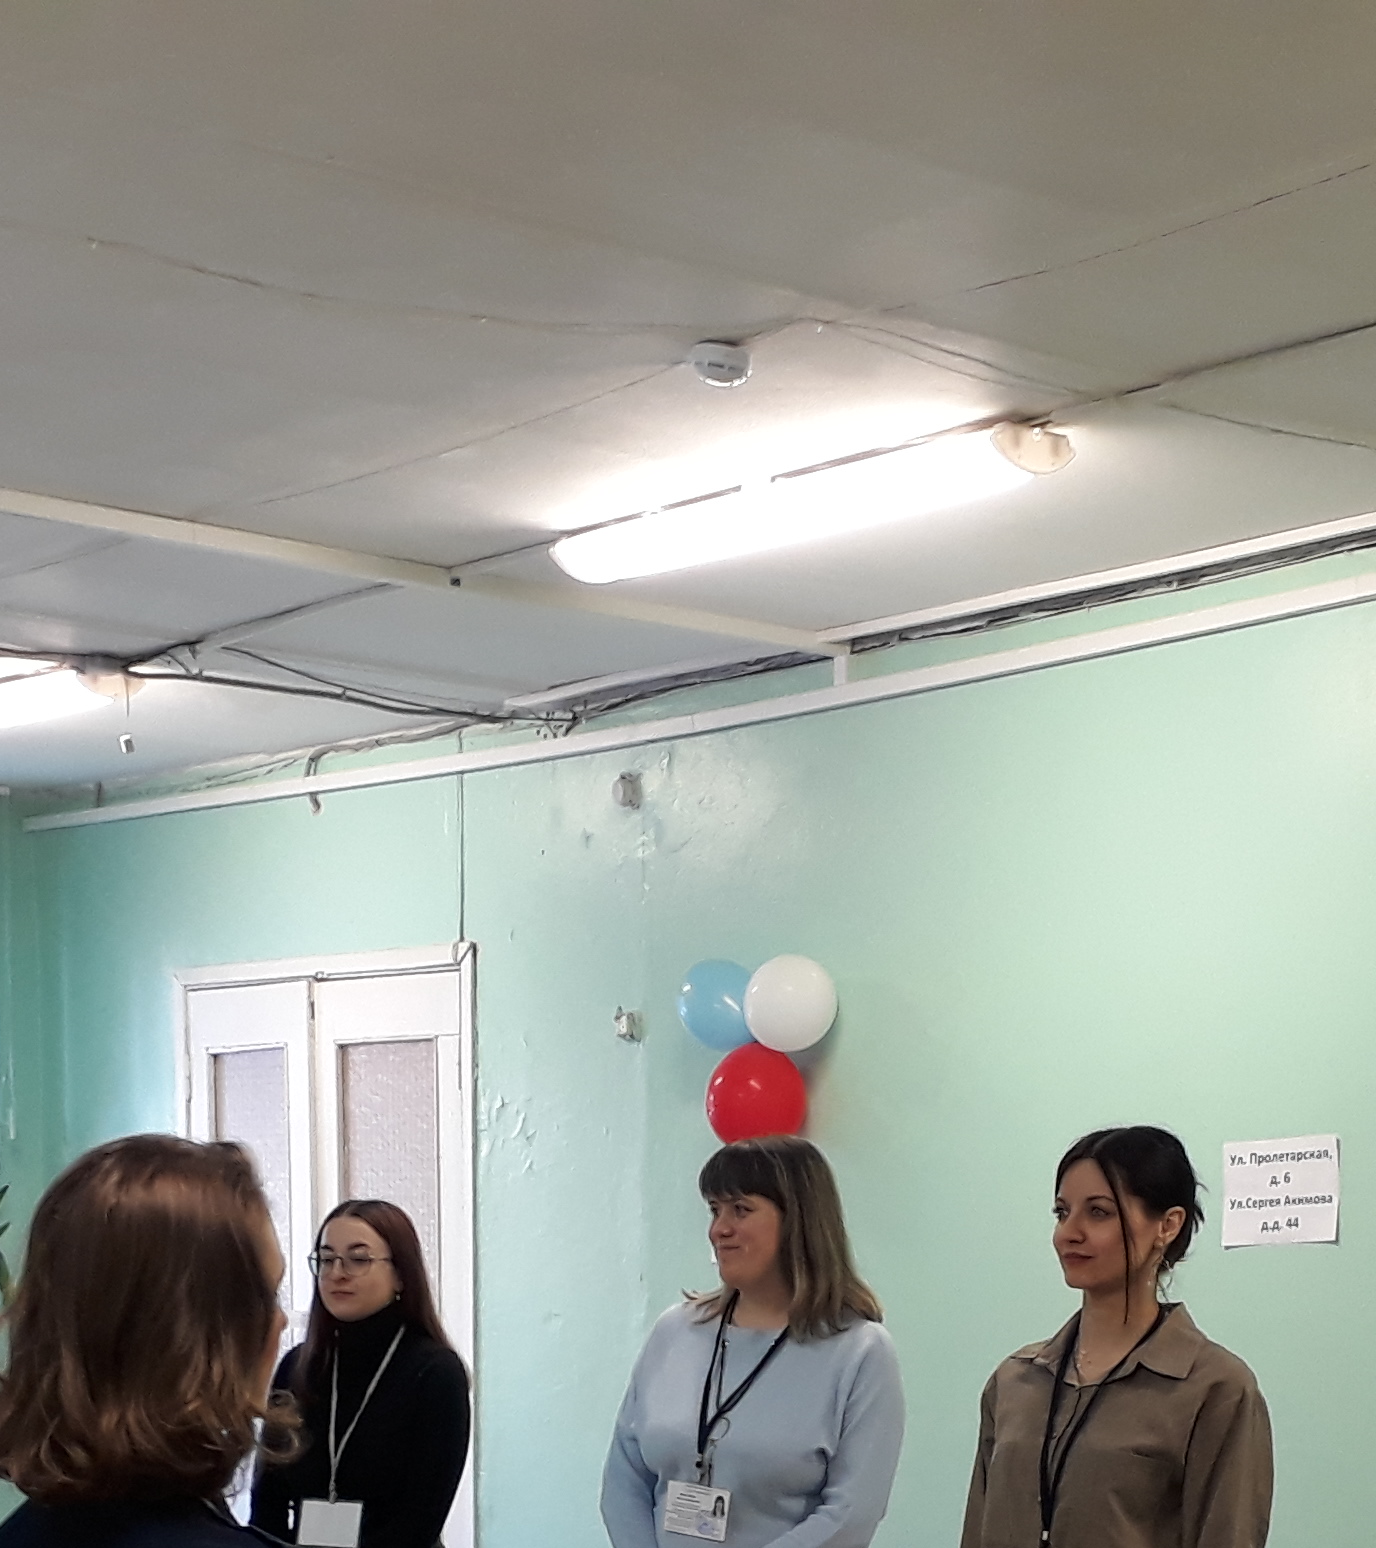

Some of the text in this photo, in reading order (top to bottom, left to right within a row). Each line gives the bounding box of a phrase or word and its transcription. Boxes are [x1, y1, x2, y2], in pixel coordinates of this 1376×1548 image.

[1230, 1149, 1332, 1166] Ул. Пролетарская,
[1269, 1172, 1291, 1187] д. 6
[1284, 1195, 1332, 1205] Акимова
[1286, 1218, 1299, 1228] 44
